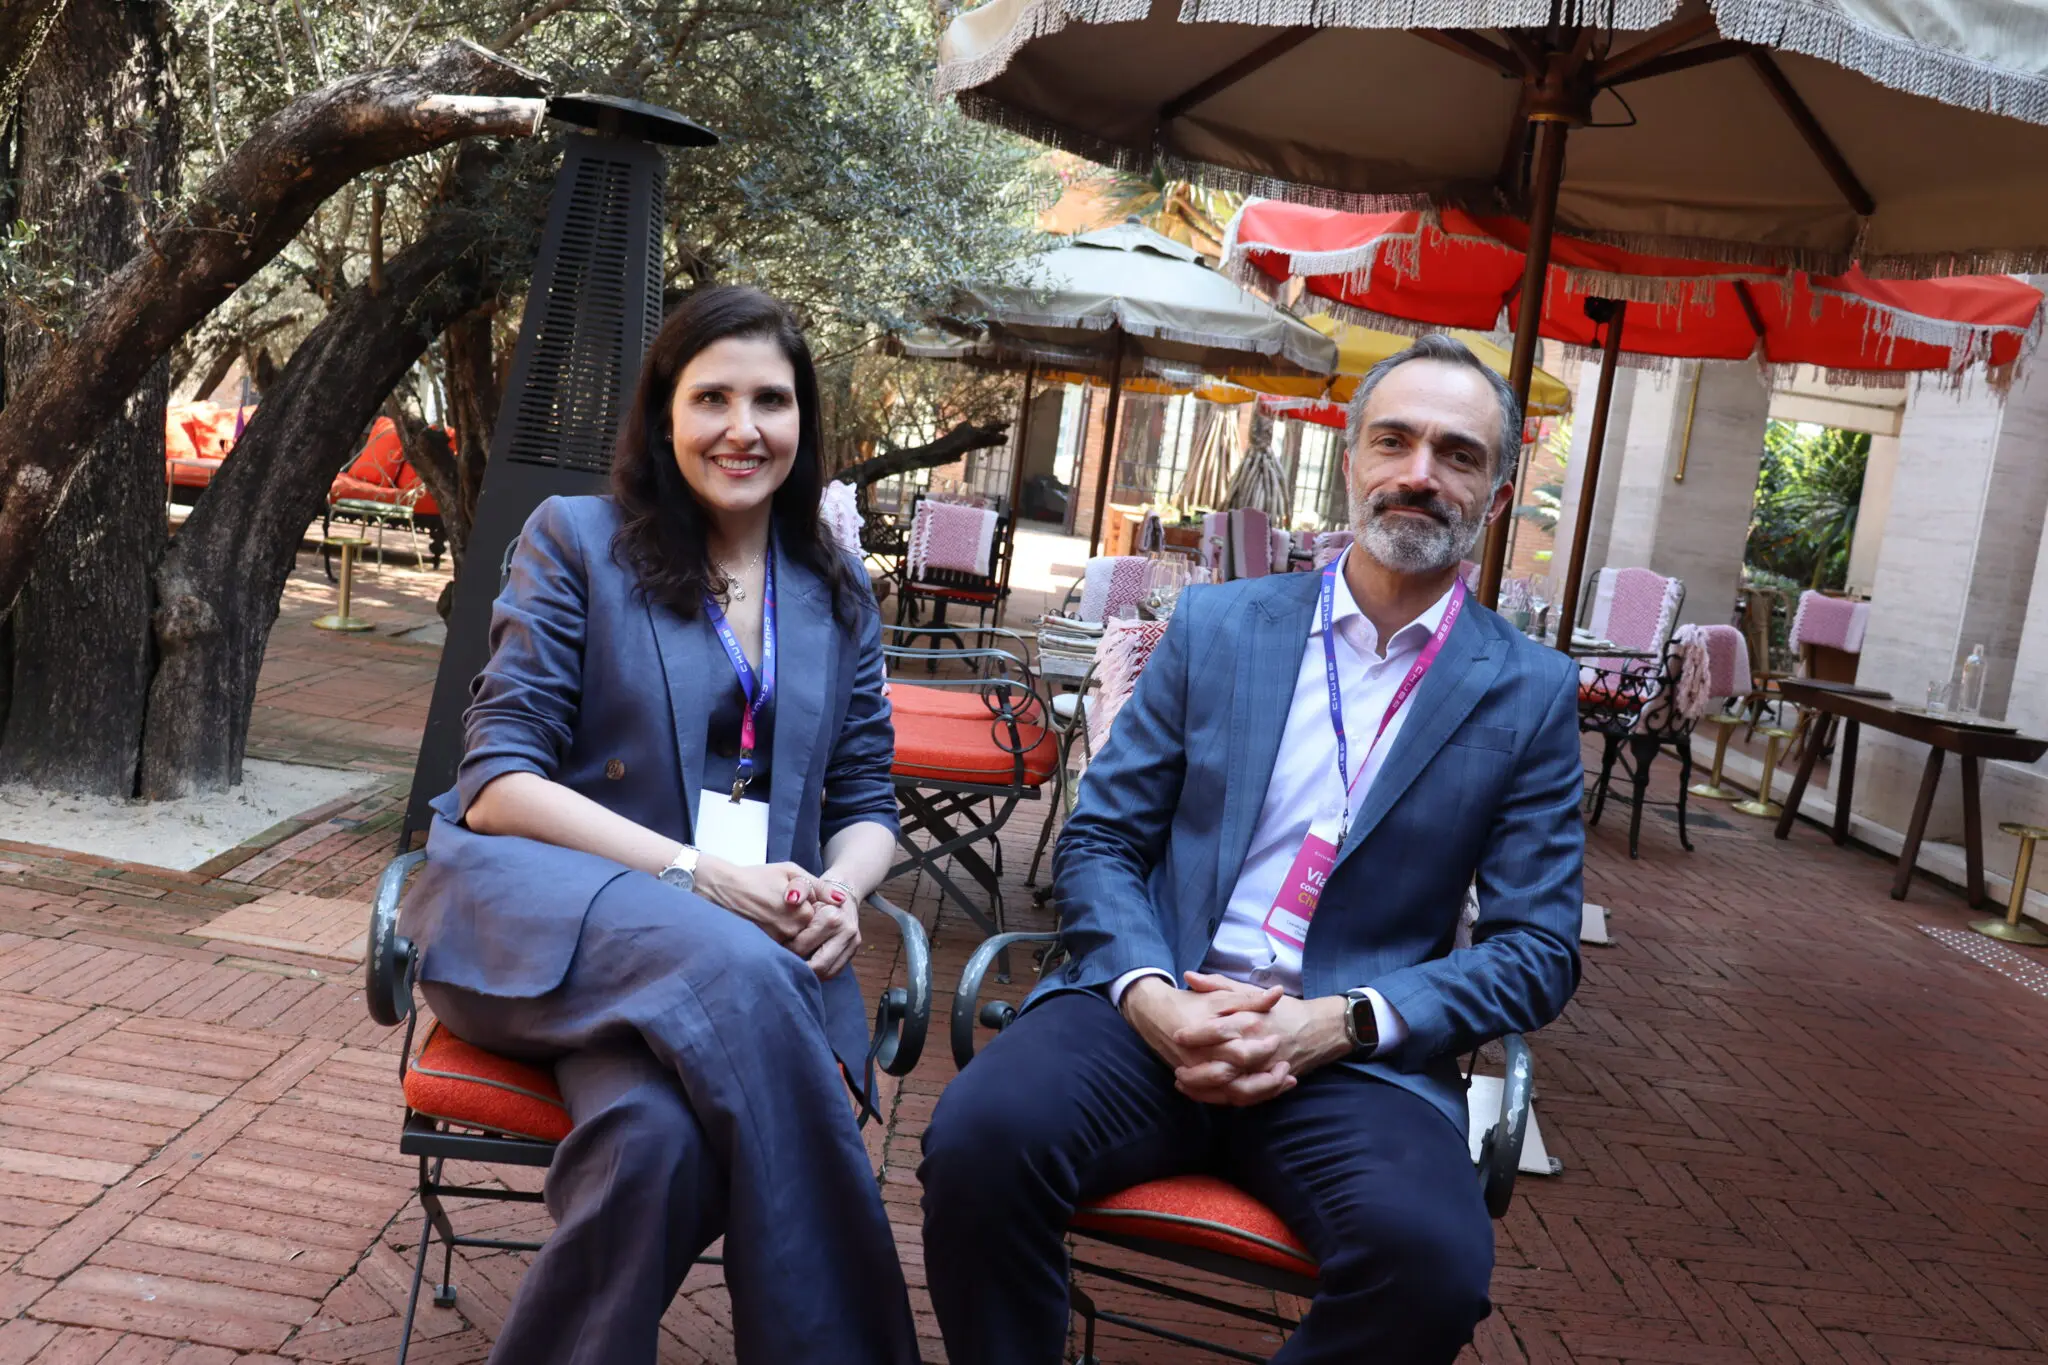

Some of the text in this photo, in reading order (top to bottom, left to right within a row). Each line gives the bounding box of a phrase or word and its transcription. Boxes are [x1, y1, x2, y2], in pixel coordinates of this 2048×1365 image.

[1323, 584, 1331, 631] CHUBB
[1436, 599, 1460, 640] CHUBB
[723, 629, 748, 673] CHUBB
[764, 616, 772, 657] CHUBB
[1328, 662, 1338, 711] CHUBB
[1392, 665, 1423, 709] CHUBB
[1299, 882, 1318, 896] com
